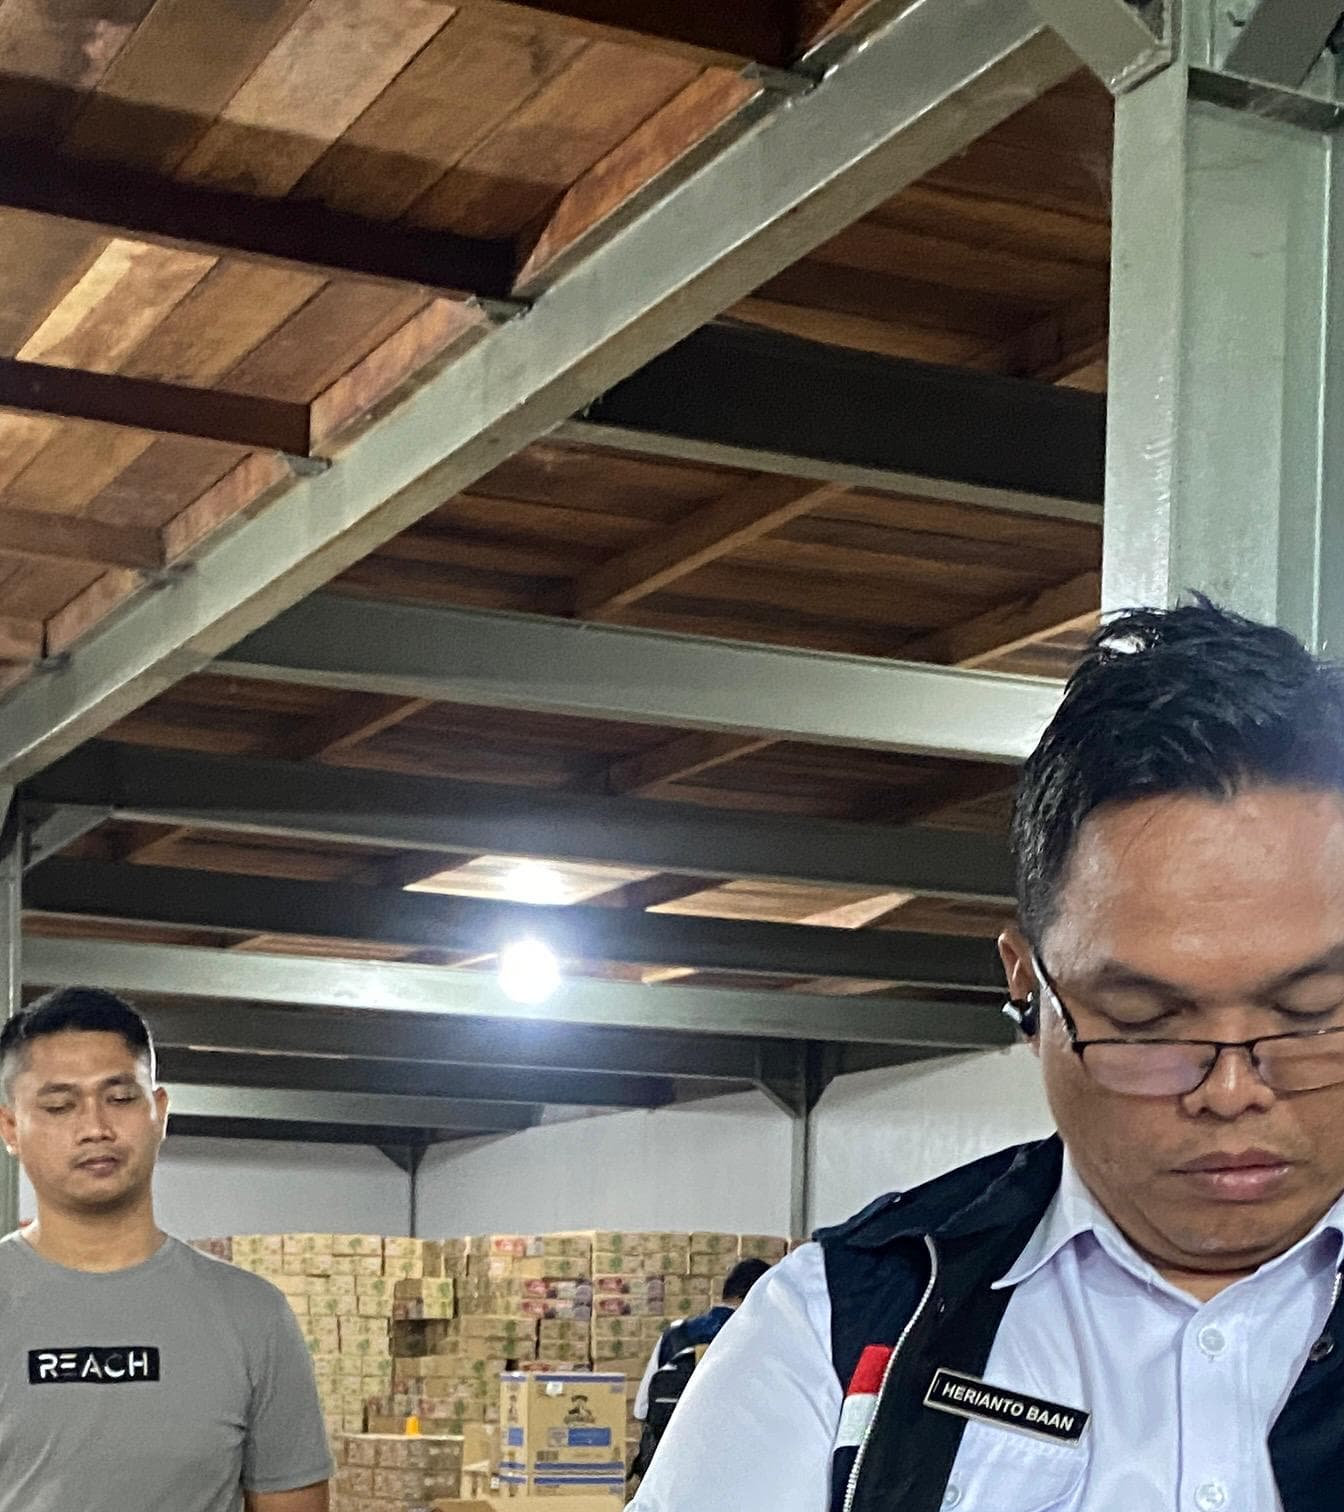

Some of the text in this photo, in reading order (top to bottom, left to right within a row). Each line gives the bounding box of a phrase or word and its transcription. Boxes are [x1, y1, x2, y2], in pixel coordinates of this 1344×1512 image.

[39, 1351, 150, 1378] REACH
[943, 1382, 1075, 1432] HERIANTO BAAN
